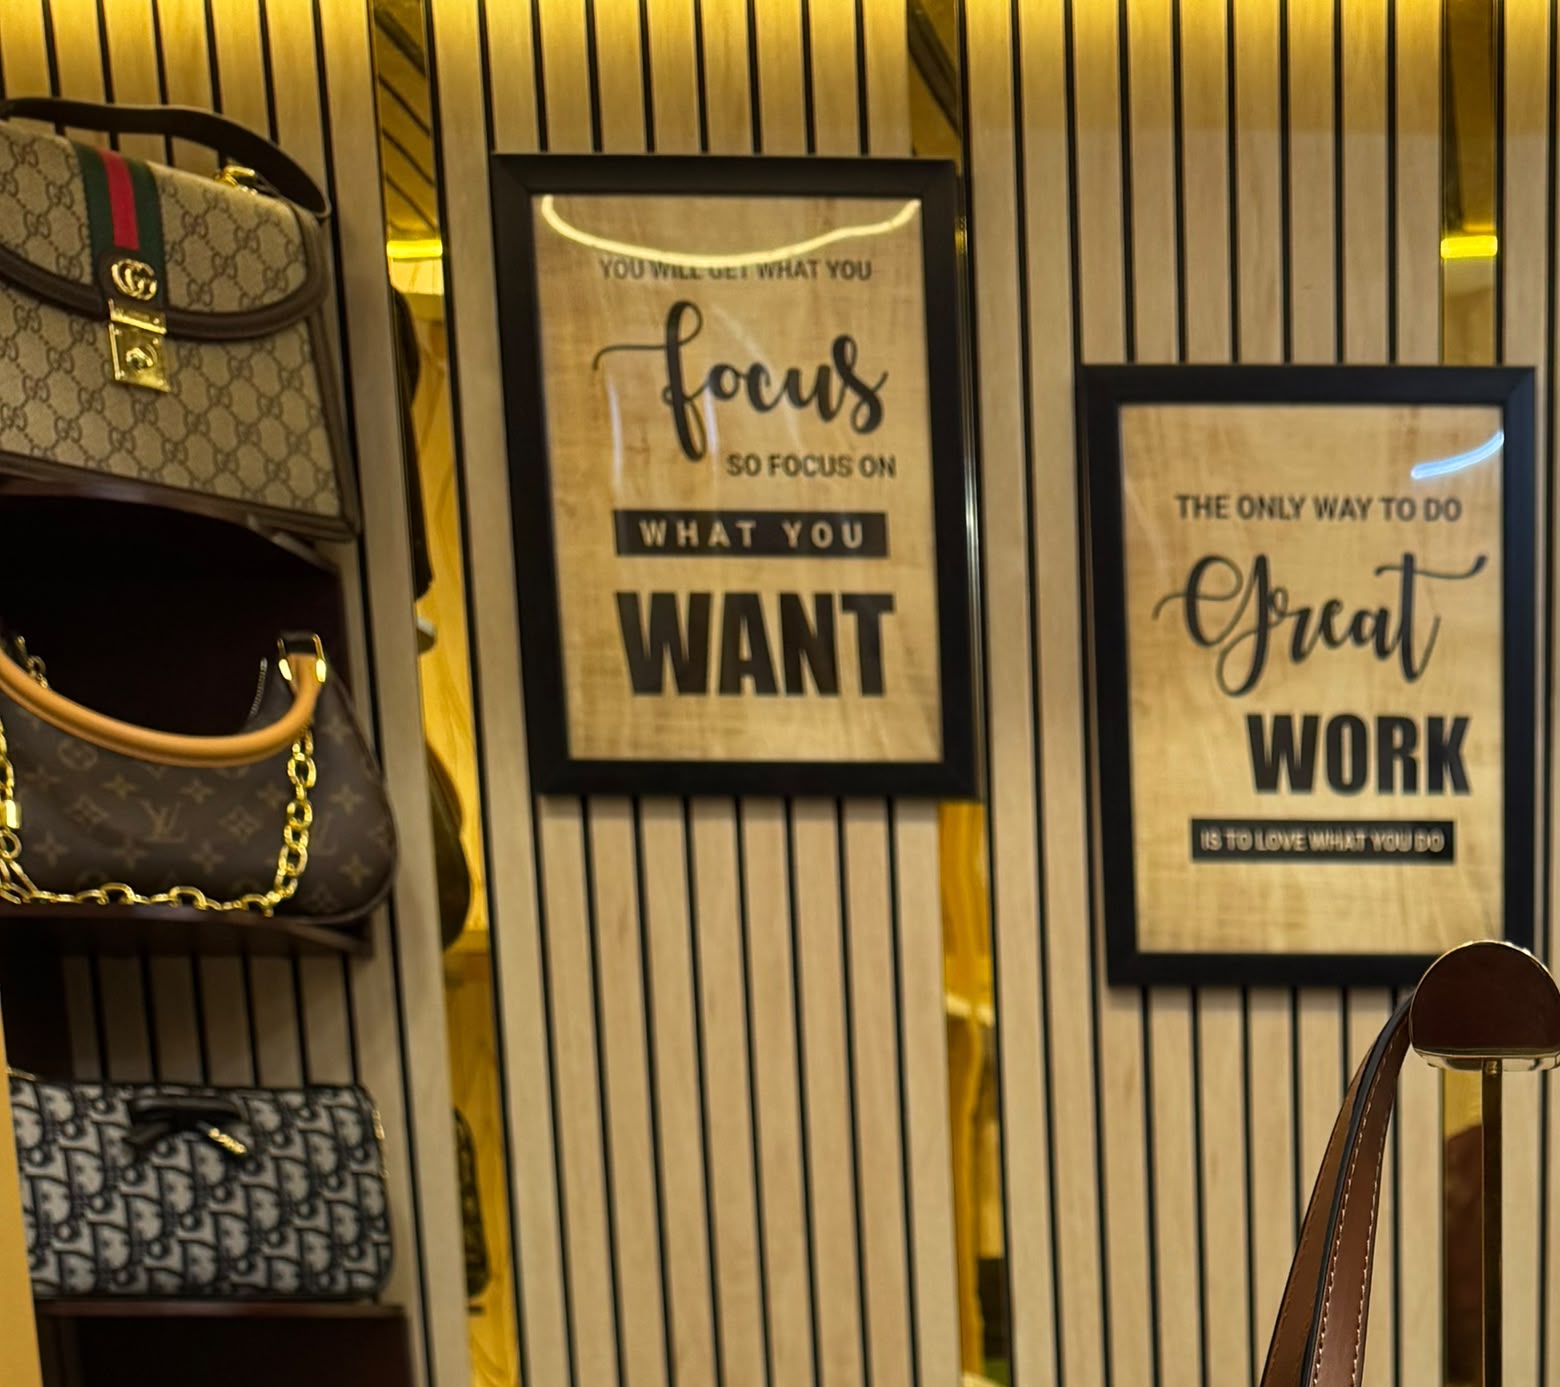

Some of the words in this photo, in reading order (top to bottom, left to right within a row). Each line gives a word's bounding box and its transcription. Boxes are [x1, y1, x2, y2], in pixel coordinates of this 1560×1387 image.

[600, 257, 644, 280] YOU
[650, 262, 701, 281] WILL
[708, 265, 750, 281] GET
[757, 260, 818, 281] WHAT
[825, 260, 872, 281] YOU
[593, 300, 889, 462] focus
[727, 454, 761, 477] SO
[768, 454, 853, 478] FOCUS
[859, 456, 896, 478] ON
[1175, 494, 1230, 520] THE
[1237, 495, 1304, 521] ONLY
[1315, 496, 1376, 521] WAY
[1380, 497, 1417, 522] TO
[1424, 497, 1462, 522] DO
[640, 519, 756, 548] WHAT
[783, 520, 865, 549] YOU
[1153, 552, 1488, 698] Great
[615, 591, 895, 697] WANT
[1246, 713, 1472, 796] WORK
[1201, 826, 1222, 851] IS
[1226, 827, 1253, 851] TO
[1255, 827, 1307, 851] LOVE
[1308, 827, 1367, 851] WHAT
[1371, 828, 1412, 852] YOU
[1414, 828, 1445, 852] DO
